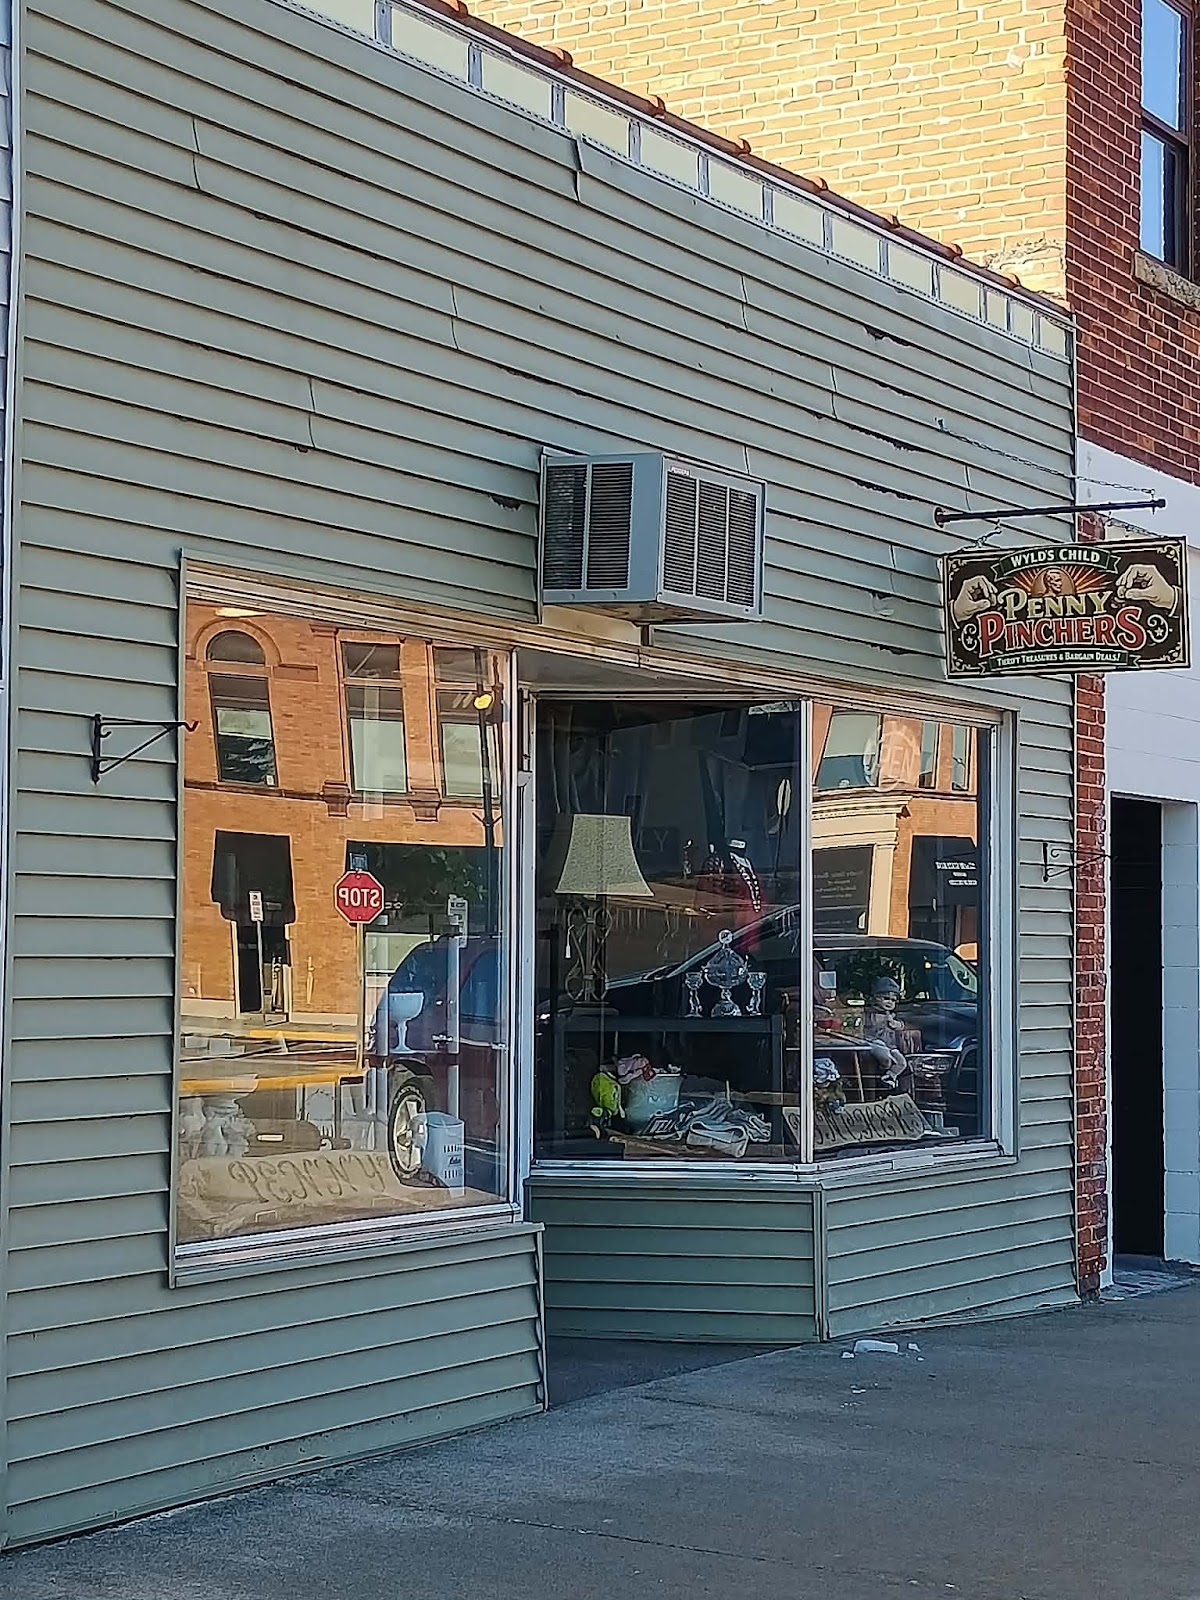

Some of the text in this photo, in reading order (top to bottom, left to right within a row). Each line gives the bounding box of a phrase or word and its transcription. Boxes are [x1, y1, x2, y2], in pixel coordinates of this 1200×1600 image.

[1010, 548, 1101, 568] WYLD'S CHILD
[997, 588, 1113, 621] PENNY
[976, 607, 1147, 658] PINCHERS
